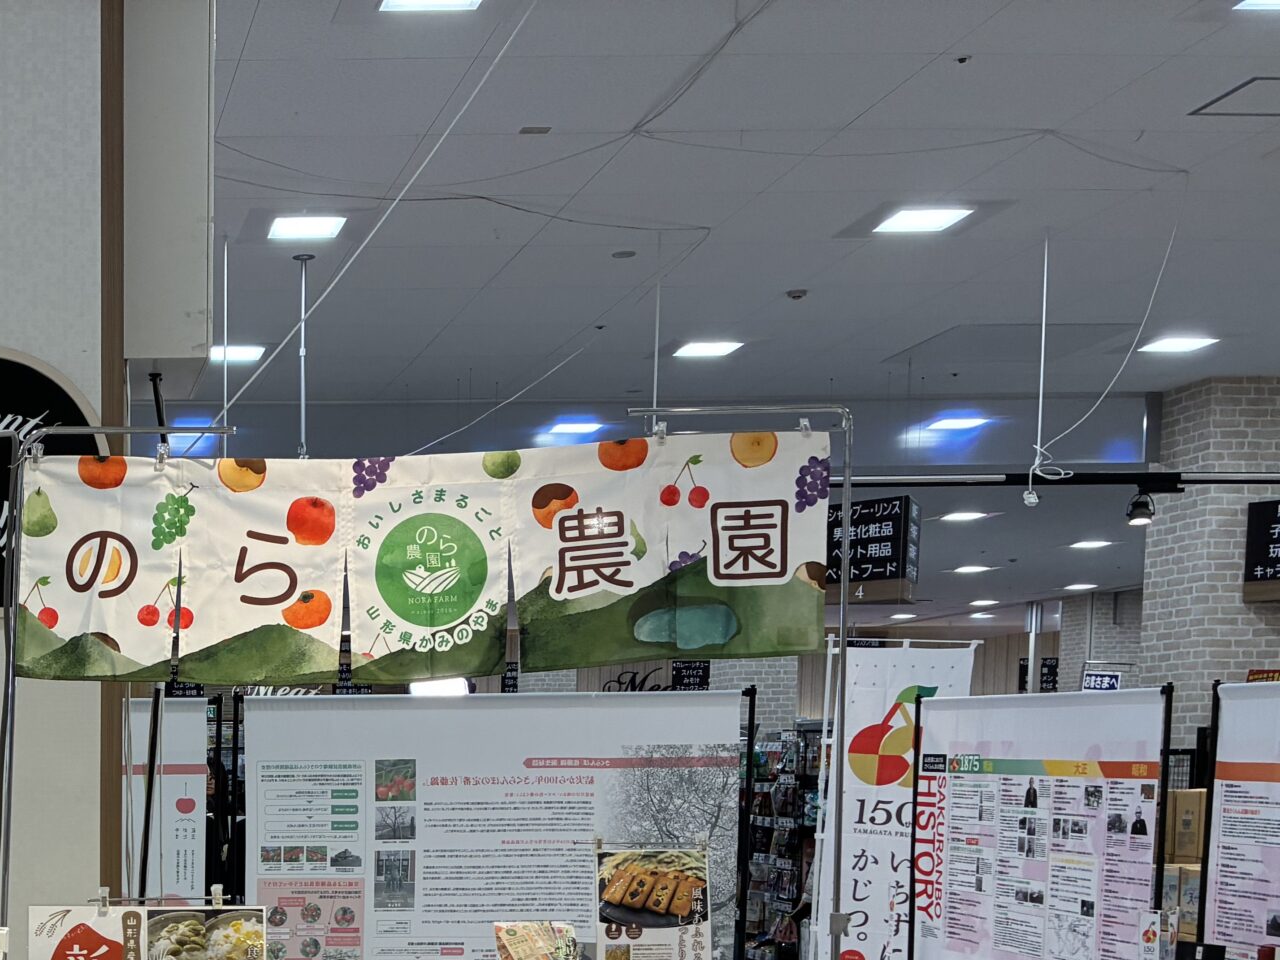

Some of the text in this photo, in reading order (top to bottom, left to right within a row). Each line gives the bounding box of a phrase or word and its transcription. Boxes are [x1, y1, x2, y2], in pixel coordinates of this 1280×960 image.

[356, 488, 502, 550] おいしさまるごと
[828, 501, 901, 521] シャプー・リンス
[833, 522, 893, 541] 男性化粧品
[825, 562, 898, 579] ペトフード
[408, 595, 458, 605] NORA FARM
[855, 584, 865, 599] 4
[366, 599, 500, 649] 山形県かみのやま
[959, 755, 980, 772] 1875
[914, 774, 938, 922] HISTORY
[932, 775, 948, 921] SAKURANBO
